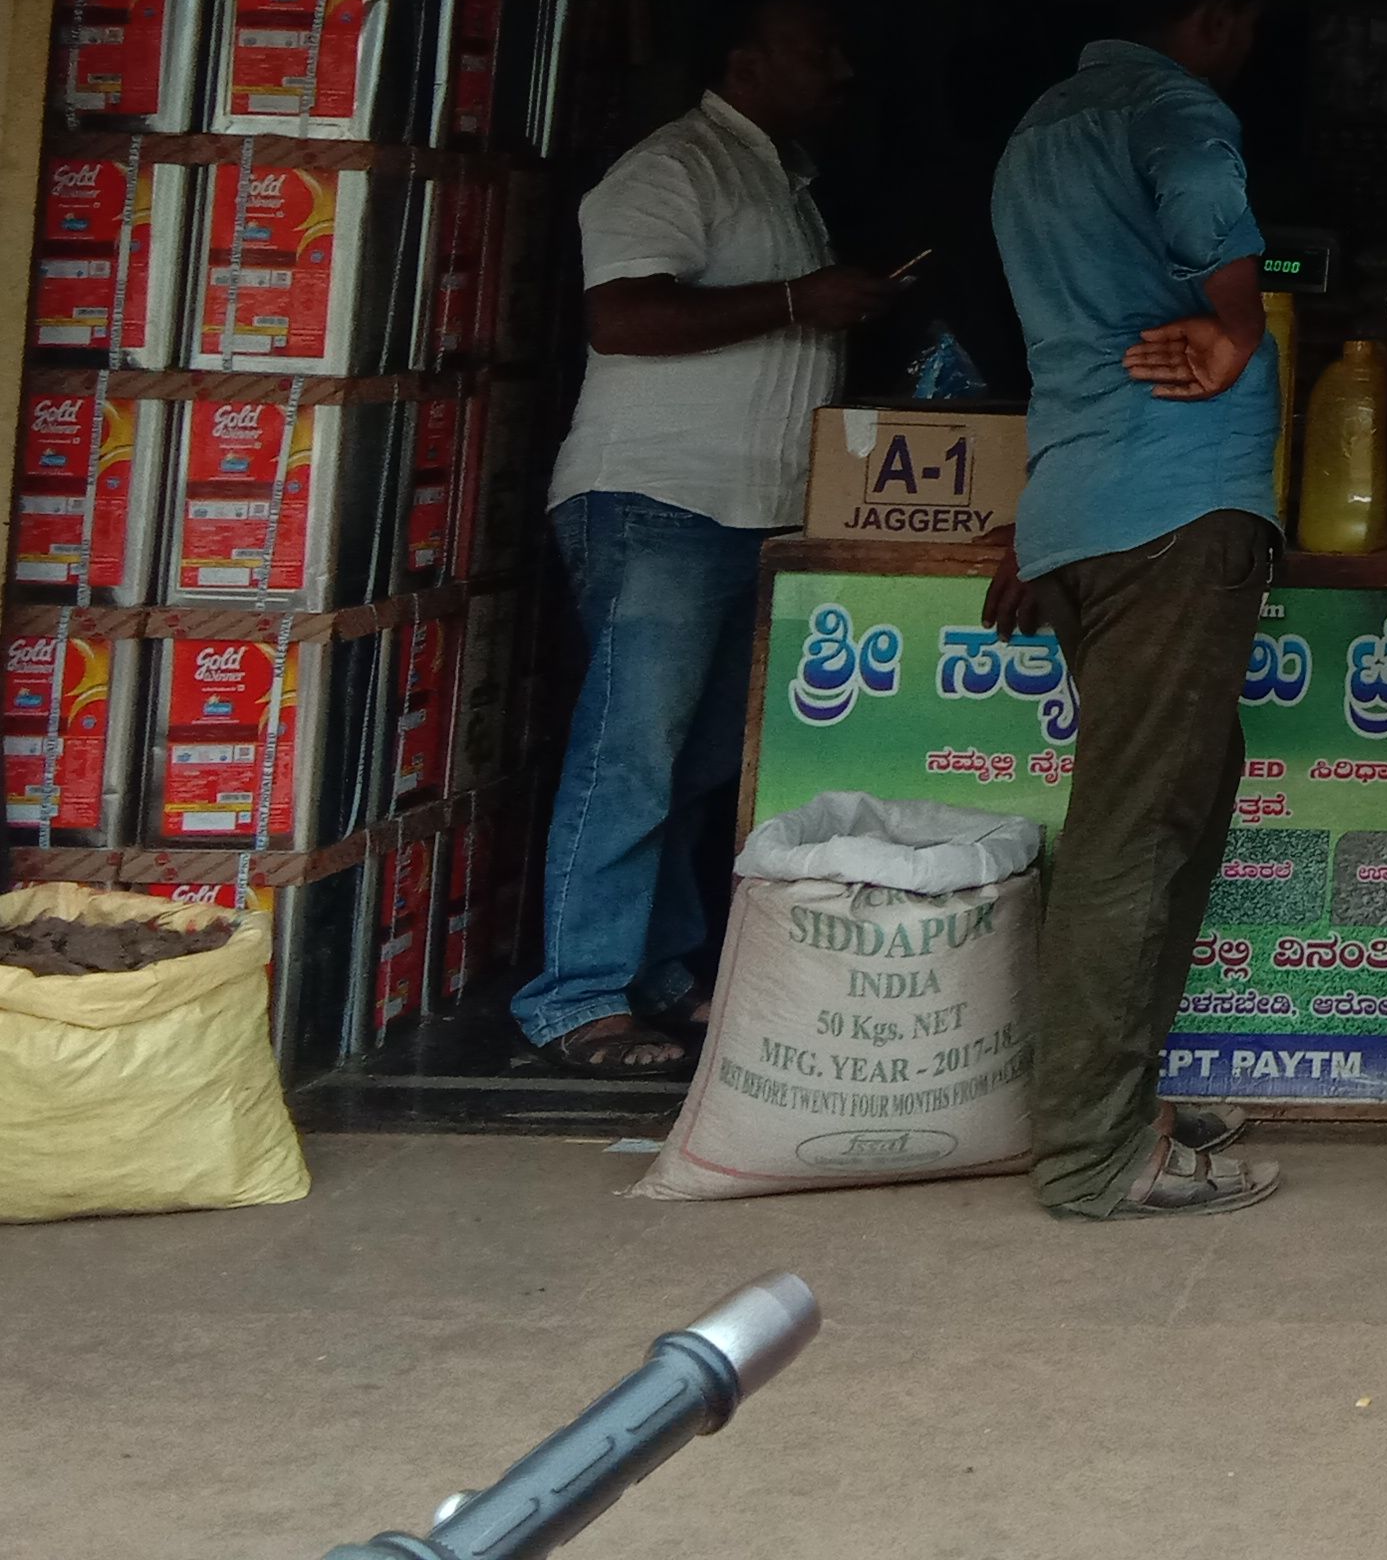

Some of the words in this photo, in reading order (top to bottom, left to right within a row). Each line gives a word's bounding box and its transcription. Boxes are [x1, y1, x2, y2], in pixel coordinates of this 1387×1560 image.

[52, 164, 102, 188] Gold
[32, 398, 84, 427] Gold
[212, 403, 263, 432] Gold
[871, 433, 969, 496] A-1
[843, 506, 995, 534] JAGGERY
[8, 638, 57, 665] Gold
[195, 646, 245, 674] Gold
[788, 602, 905, 727] ಶ್ರೀ
[927, 748, 1017, 785] ನಮ್ಮಲ್ಲಿ
[788, 901, 999, 959] SIDDAPUR
[1190, 933, 1252, 981] ರಲ್ಲಿ
[846, 968, 942, 1000] INDIA
[815, 1009, 845, 1039] 50
[851, 1014, 905, 1048] Kgs.
[910, 1000, 969, 1040] NET
[759, 1036, 824, 1078] MFG.
[830, 1054, 911, 1084] YEAR
[1231, 1049, 1363, 1080] PAYTM
[740, 1074, 788, 1109] BEFORE
[790, 1085, 848, 1118] TWENTY
[849, 1091, 889, 1118] FOUR
[890, 1086, 951, 1118] MONTHS
[951, 1070, 990, 1107] FROM
